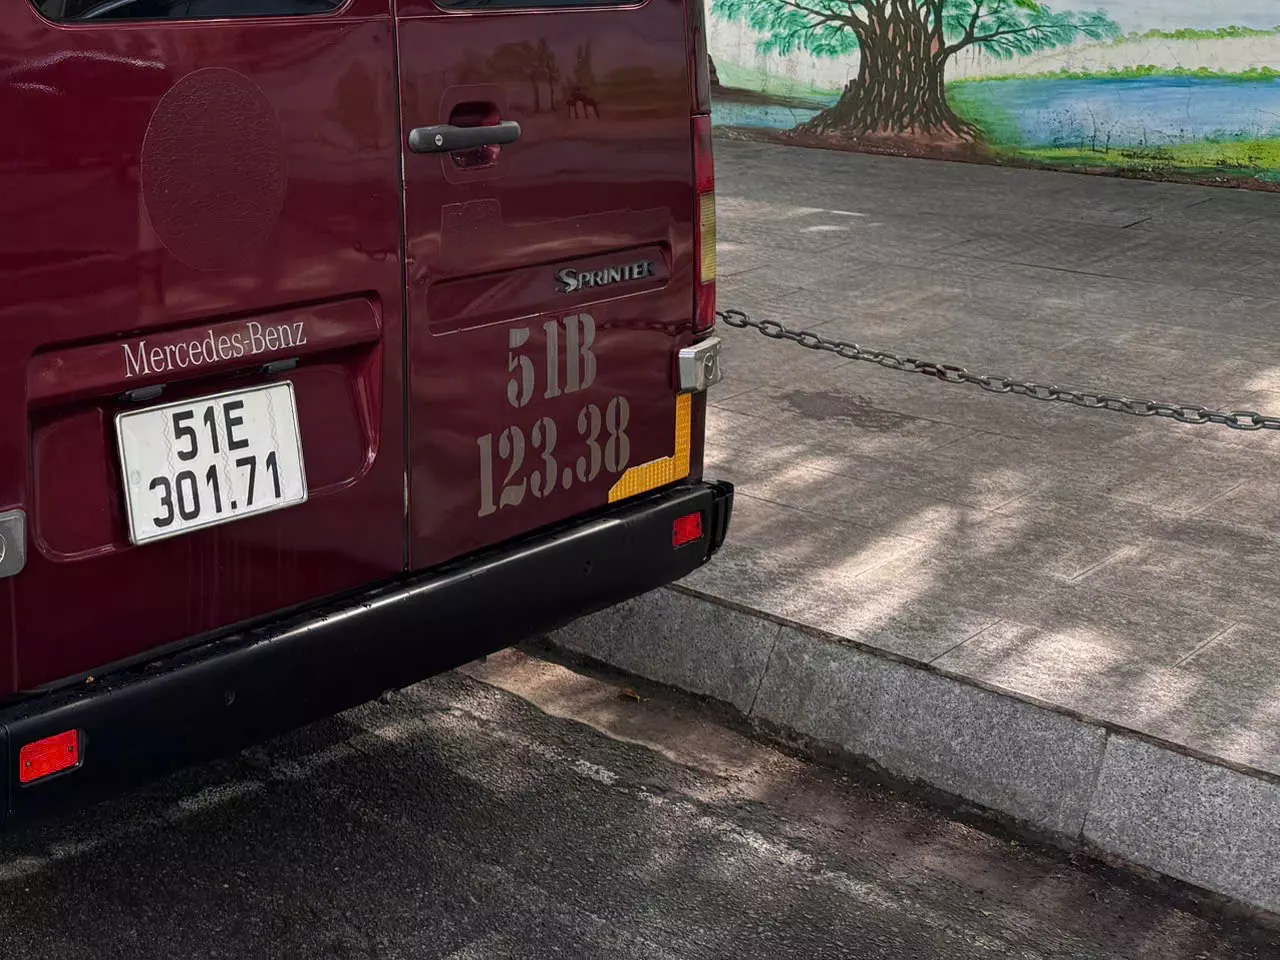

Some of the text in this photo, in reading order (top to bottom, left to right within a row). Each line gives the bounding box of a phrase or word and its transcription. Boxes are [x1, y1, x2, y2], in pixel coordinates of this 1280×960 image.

[123, 318, 308, 379] Mercedes-Benz
[507, 312, 598, 408] 51B
[172, 400, 250, 462] 51E
[477, 395, 632, 519] 123.38
[149, 450, 282, 528] 301.71
